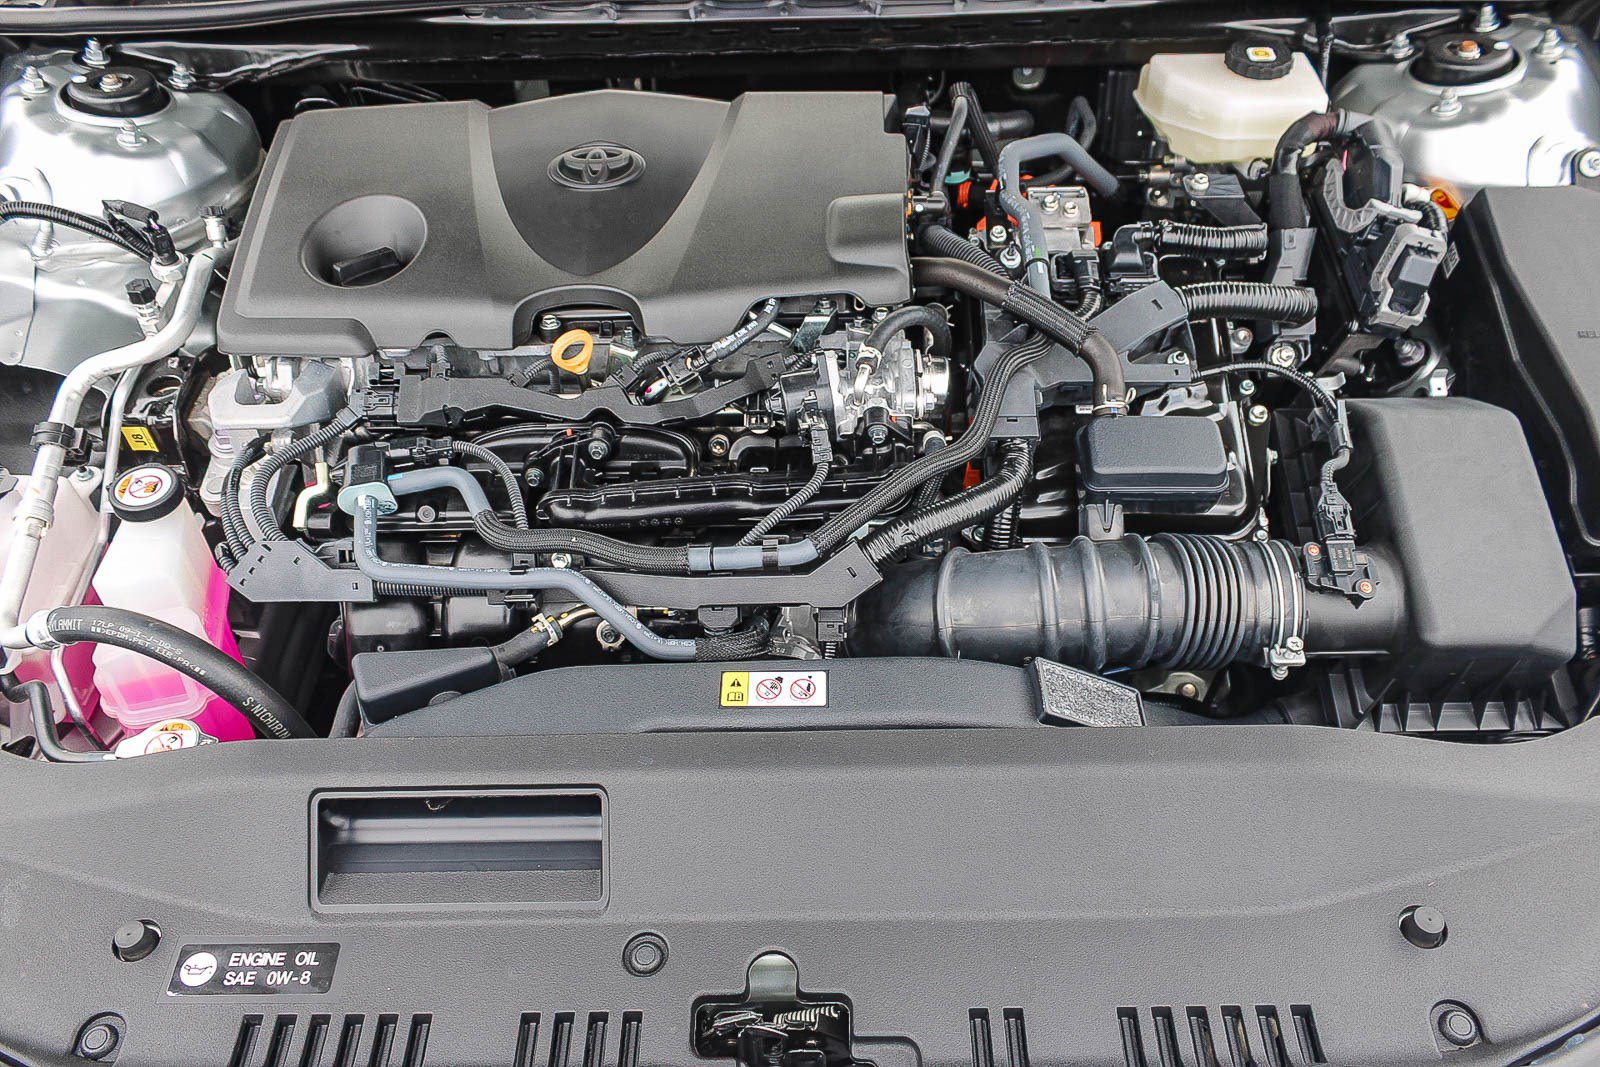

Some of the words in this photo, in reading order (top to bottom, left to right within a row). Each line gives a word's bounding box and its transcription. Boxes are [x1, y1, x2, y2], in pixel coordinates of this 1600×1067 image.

[131, 434, 147, 446] J8
[228, 952, 287, 967] ENGINE
[294, 952, 320, 966] OIL
[223, 971, 257, 986] SAE
[266, 971, 312, 985] 0W-8
